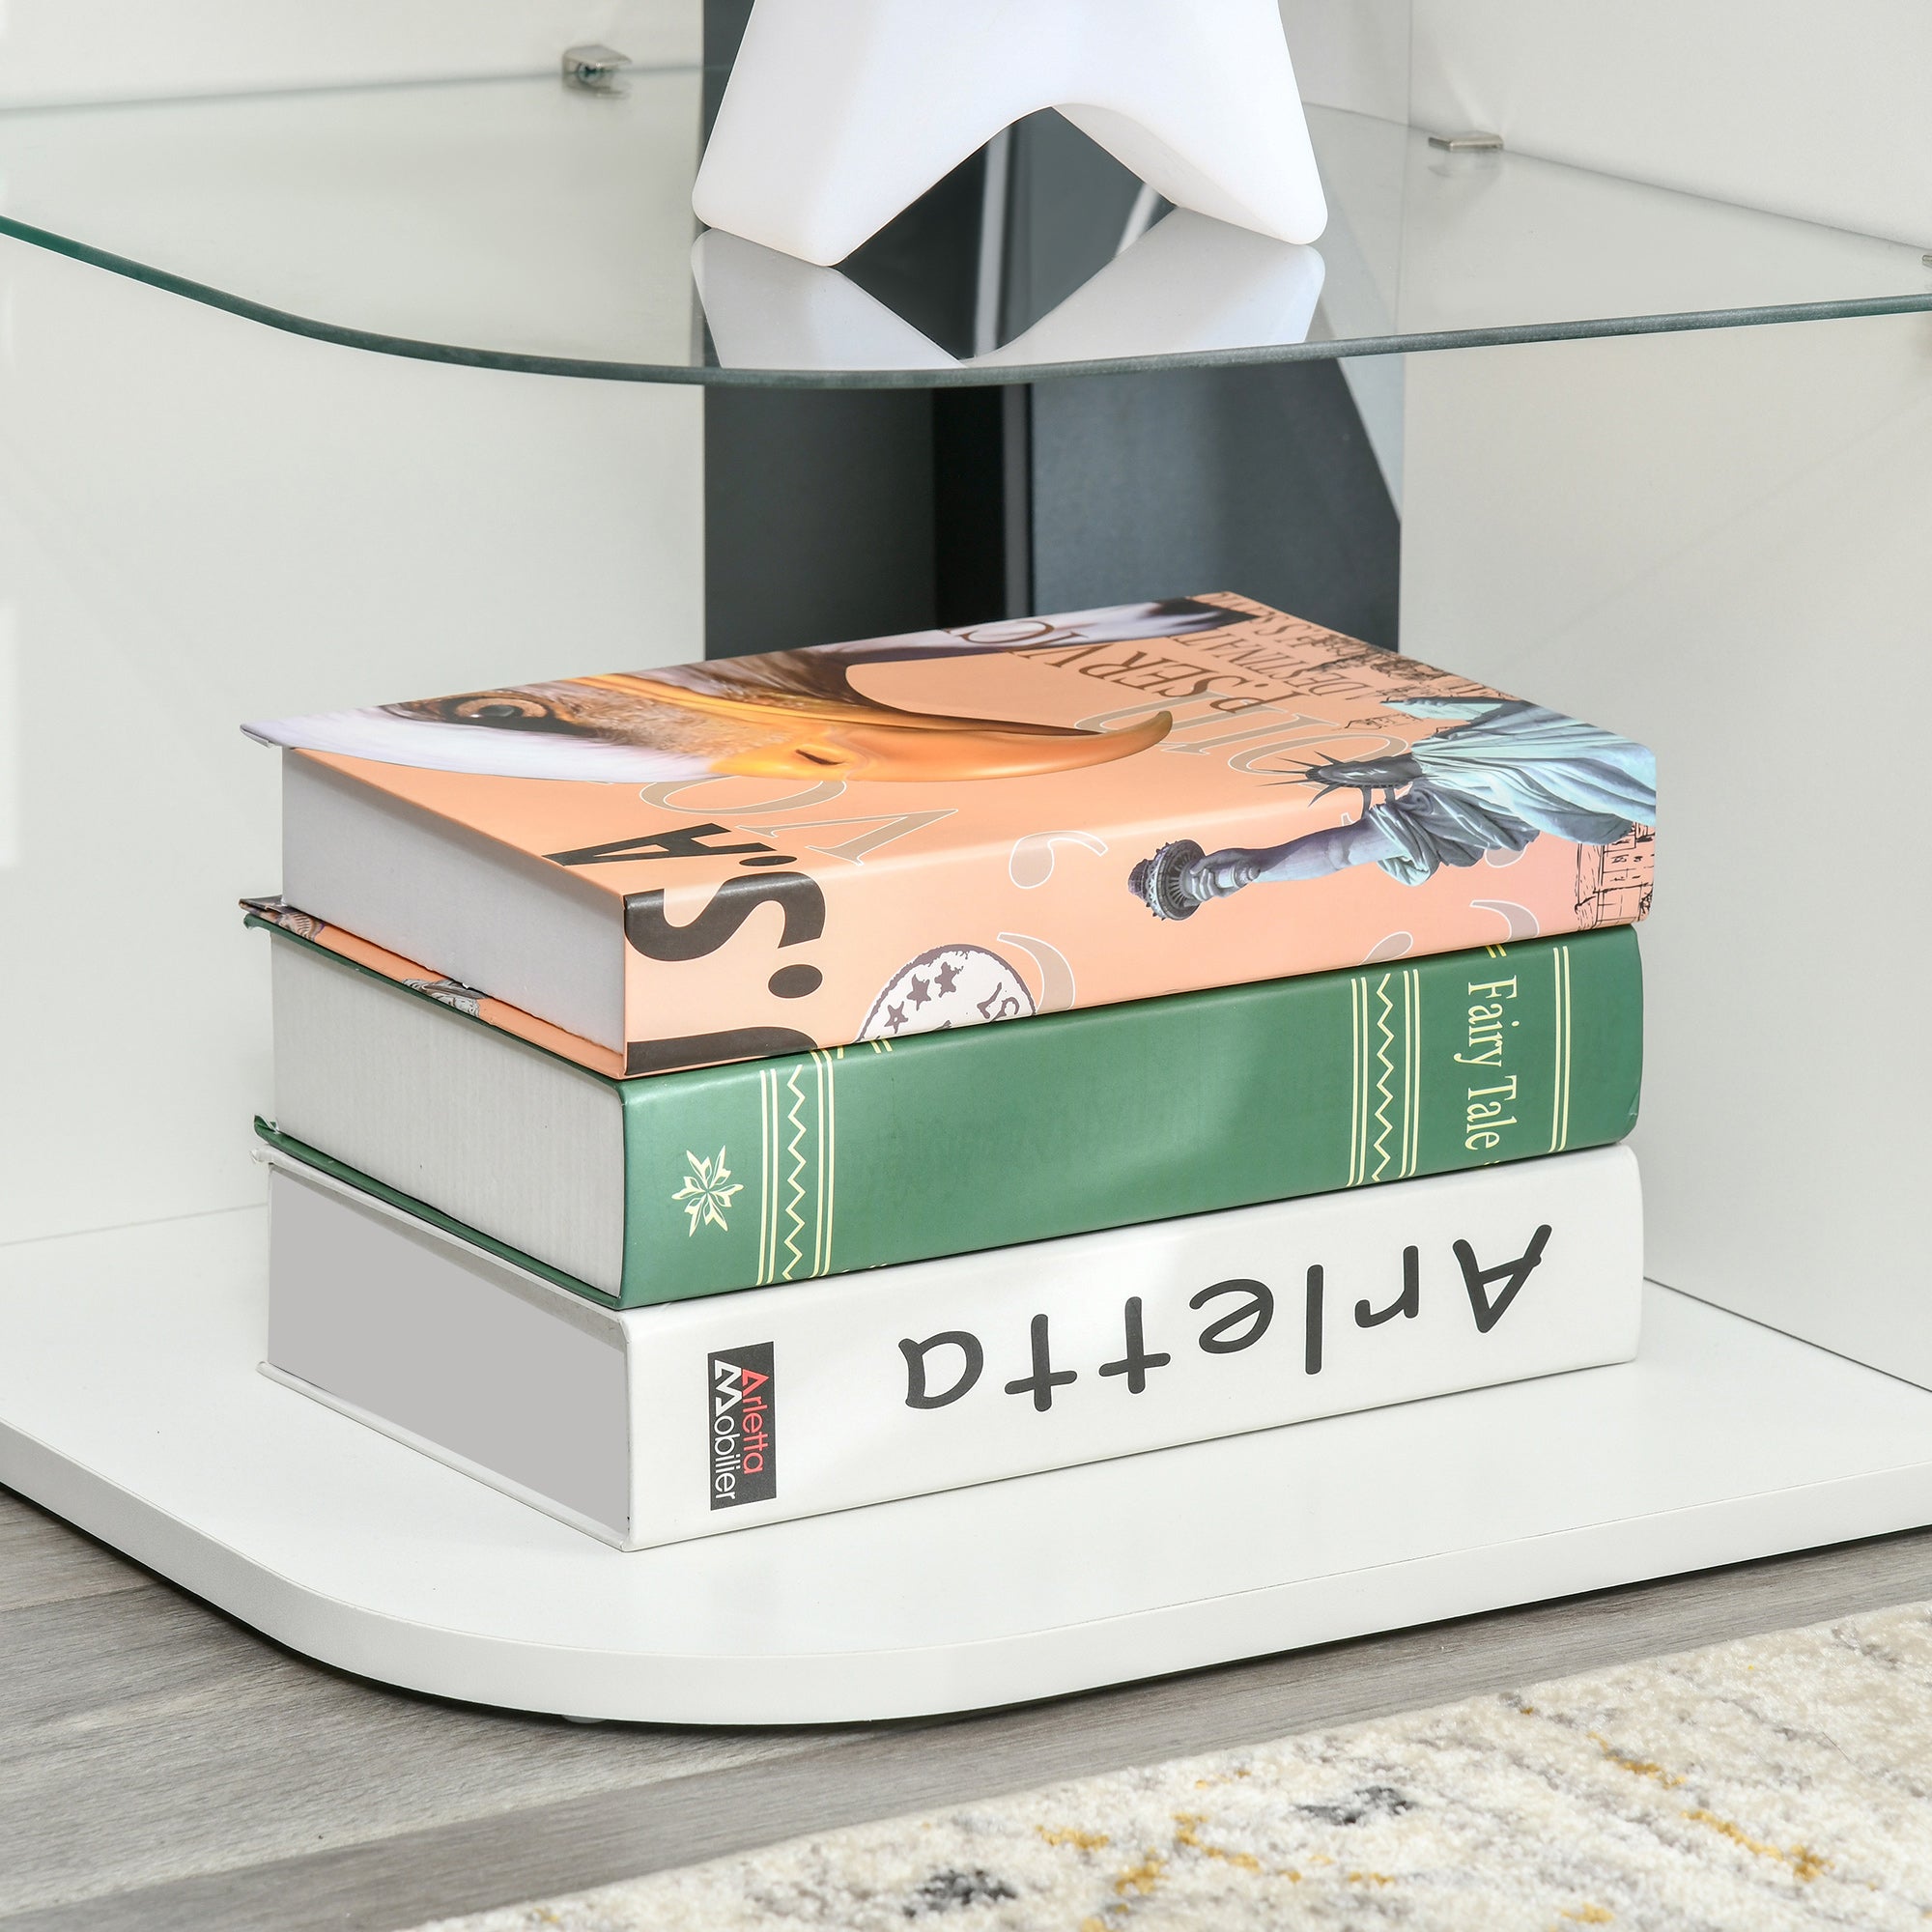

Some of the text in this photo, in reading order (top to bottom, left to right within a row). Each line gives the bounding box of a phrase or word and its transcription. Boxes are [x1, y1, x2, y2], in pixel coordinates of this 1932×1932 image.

[943, 620, 1313, 714] P.SERVIC
[1454, 975, 1520, 1151] Fairy Tale
[898, 1224, 1552, 1412] Arletta
[714, 1359, 743, 1499] Mobilier
[742, 1368, 770, 1474] Arletta
